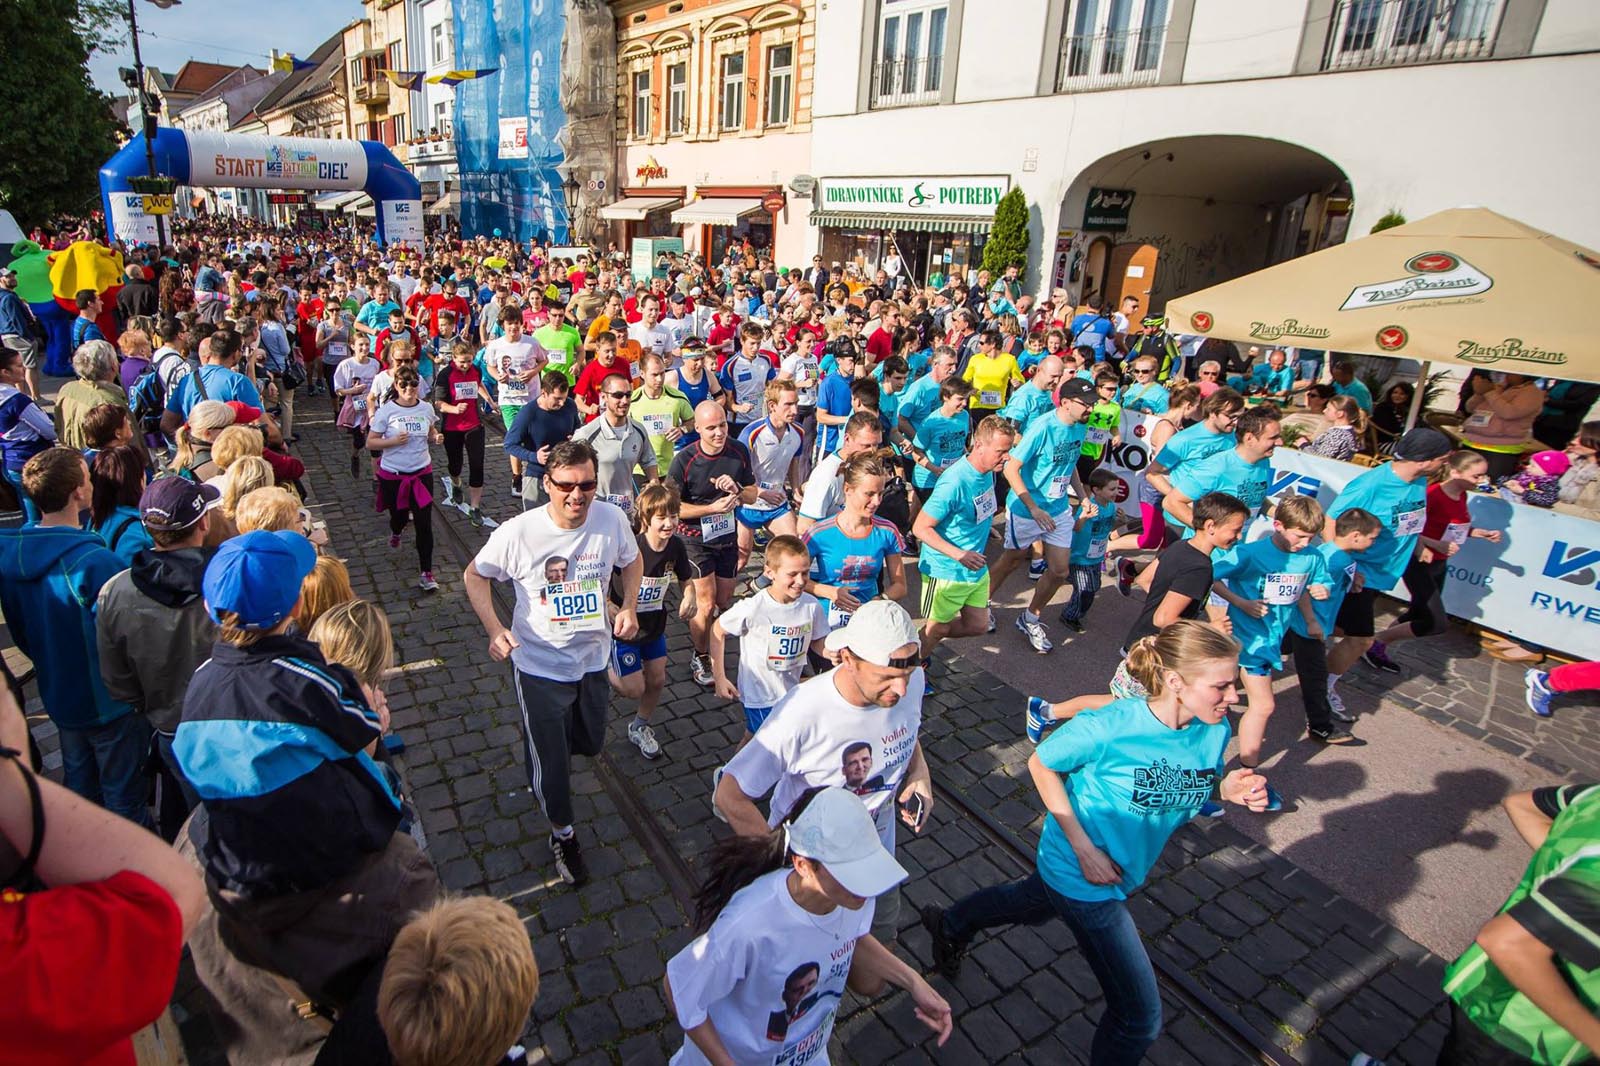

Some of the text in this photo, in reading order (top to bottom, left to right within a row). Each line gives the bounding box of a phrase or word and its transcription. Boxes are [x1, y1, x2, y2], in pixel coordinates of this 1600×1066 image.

[215, 154, 265, 178] ŠTART
[150, 197, 170, 208] WC
[825, 184, 1003, 205] ZDRAVOTNÍCKE POTREBY
[1249, 319, 1330, 341] Zlatý Bažant
[1455, 338, 1568, 365] Zlatý Bažant
[405, 422, 421, 432] 1708
[1105, 438, 1152, 472] KO
[1446, 564, 1494, 588] ROUP
[1542, 540, 1600, 592] VS
[637, 586, 662, 601] 285
[1279, 585, 1298, 597] 234
[553, 593, 598, 617] 1820
[1530, 591, 1600, 625] RWE
[779, 636, 805, 655] 301
